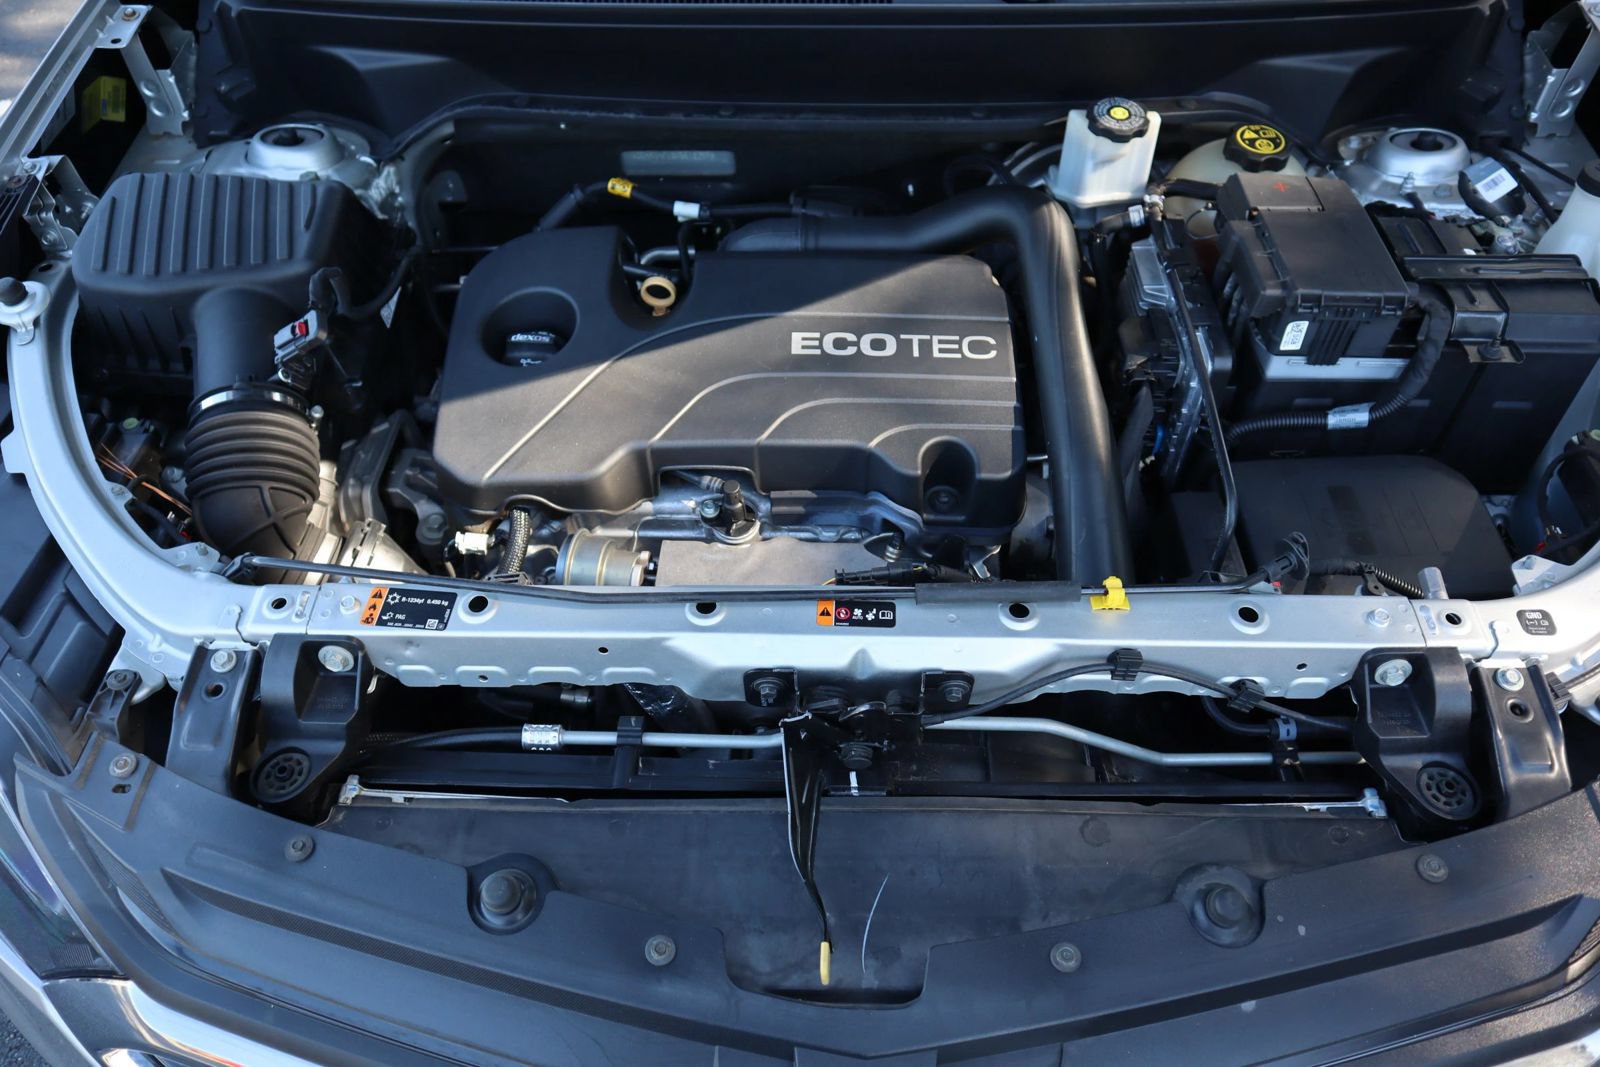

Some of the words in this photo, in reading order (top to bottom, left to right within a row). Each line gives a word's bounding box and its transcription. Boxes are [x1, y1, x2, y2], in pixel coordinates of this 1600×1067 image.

[511, 333, 550, 342] dexos
[791, 332, 998, 359] ECOTEC
[1525, 611, 1543, 619] GND
